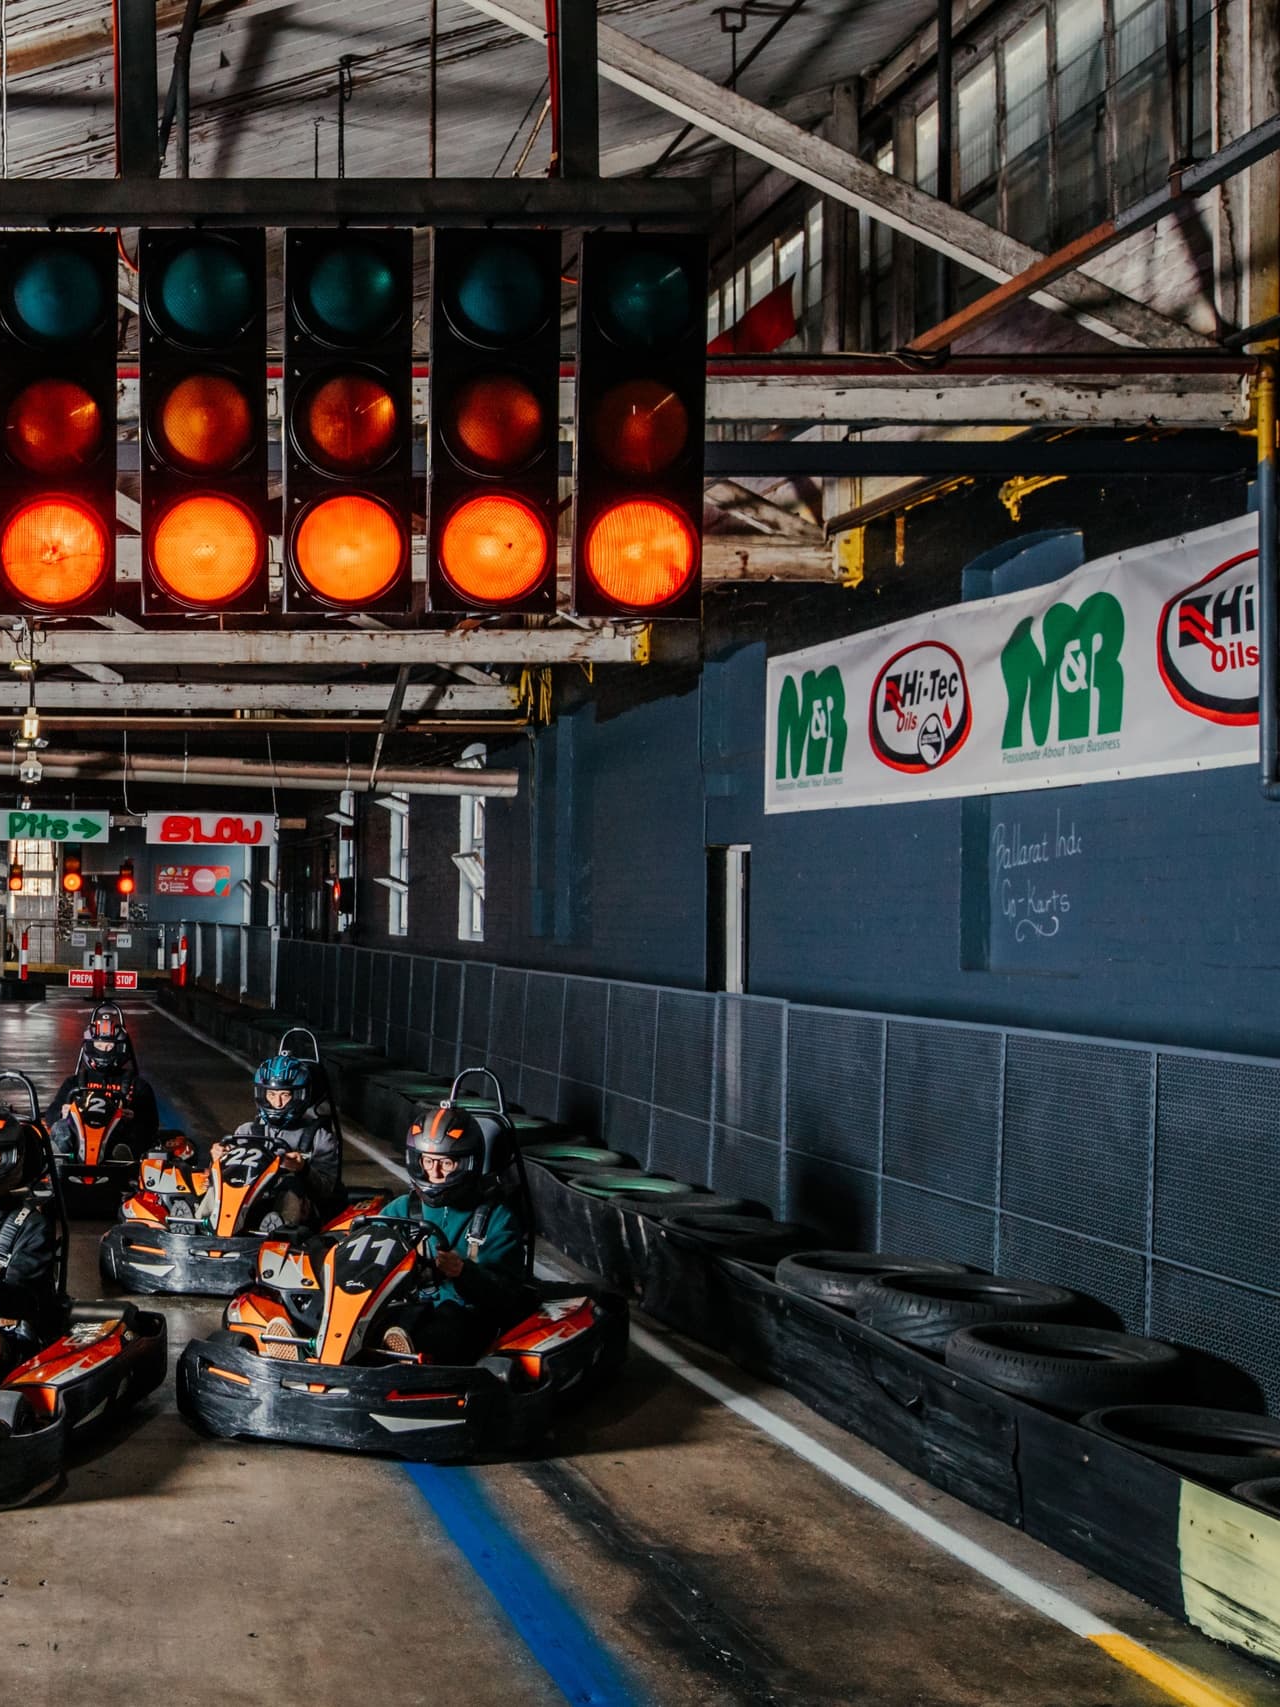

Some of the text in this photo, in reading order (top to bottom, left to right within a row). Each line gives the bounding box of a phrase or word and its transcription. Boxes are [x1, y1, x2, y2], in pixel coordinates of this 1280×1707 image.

[1001, 592, 1125, 749] M&R
[1211, 641, 1259, 672] Oils
[902, 668, 959, 707] Hi-Tec
[776, 665, 848, 779] M&R
[896, 712, 918, 732] Oils
[1002, 739, 1121, 764] Passionate About Your Business
[8, 812, 69, 840] Pits
[160, 815, 263, 844] SLOW
[992, 823, 1049, 892] Ballarat
[88, 954, 113, 967] PT
[71, 973, 134, 985] PREPA STOP
[88, 1098, 106, 1113] 2
[225, 1147, 263, 1168] 22
[347, 1234, 397, 1266] 11
